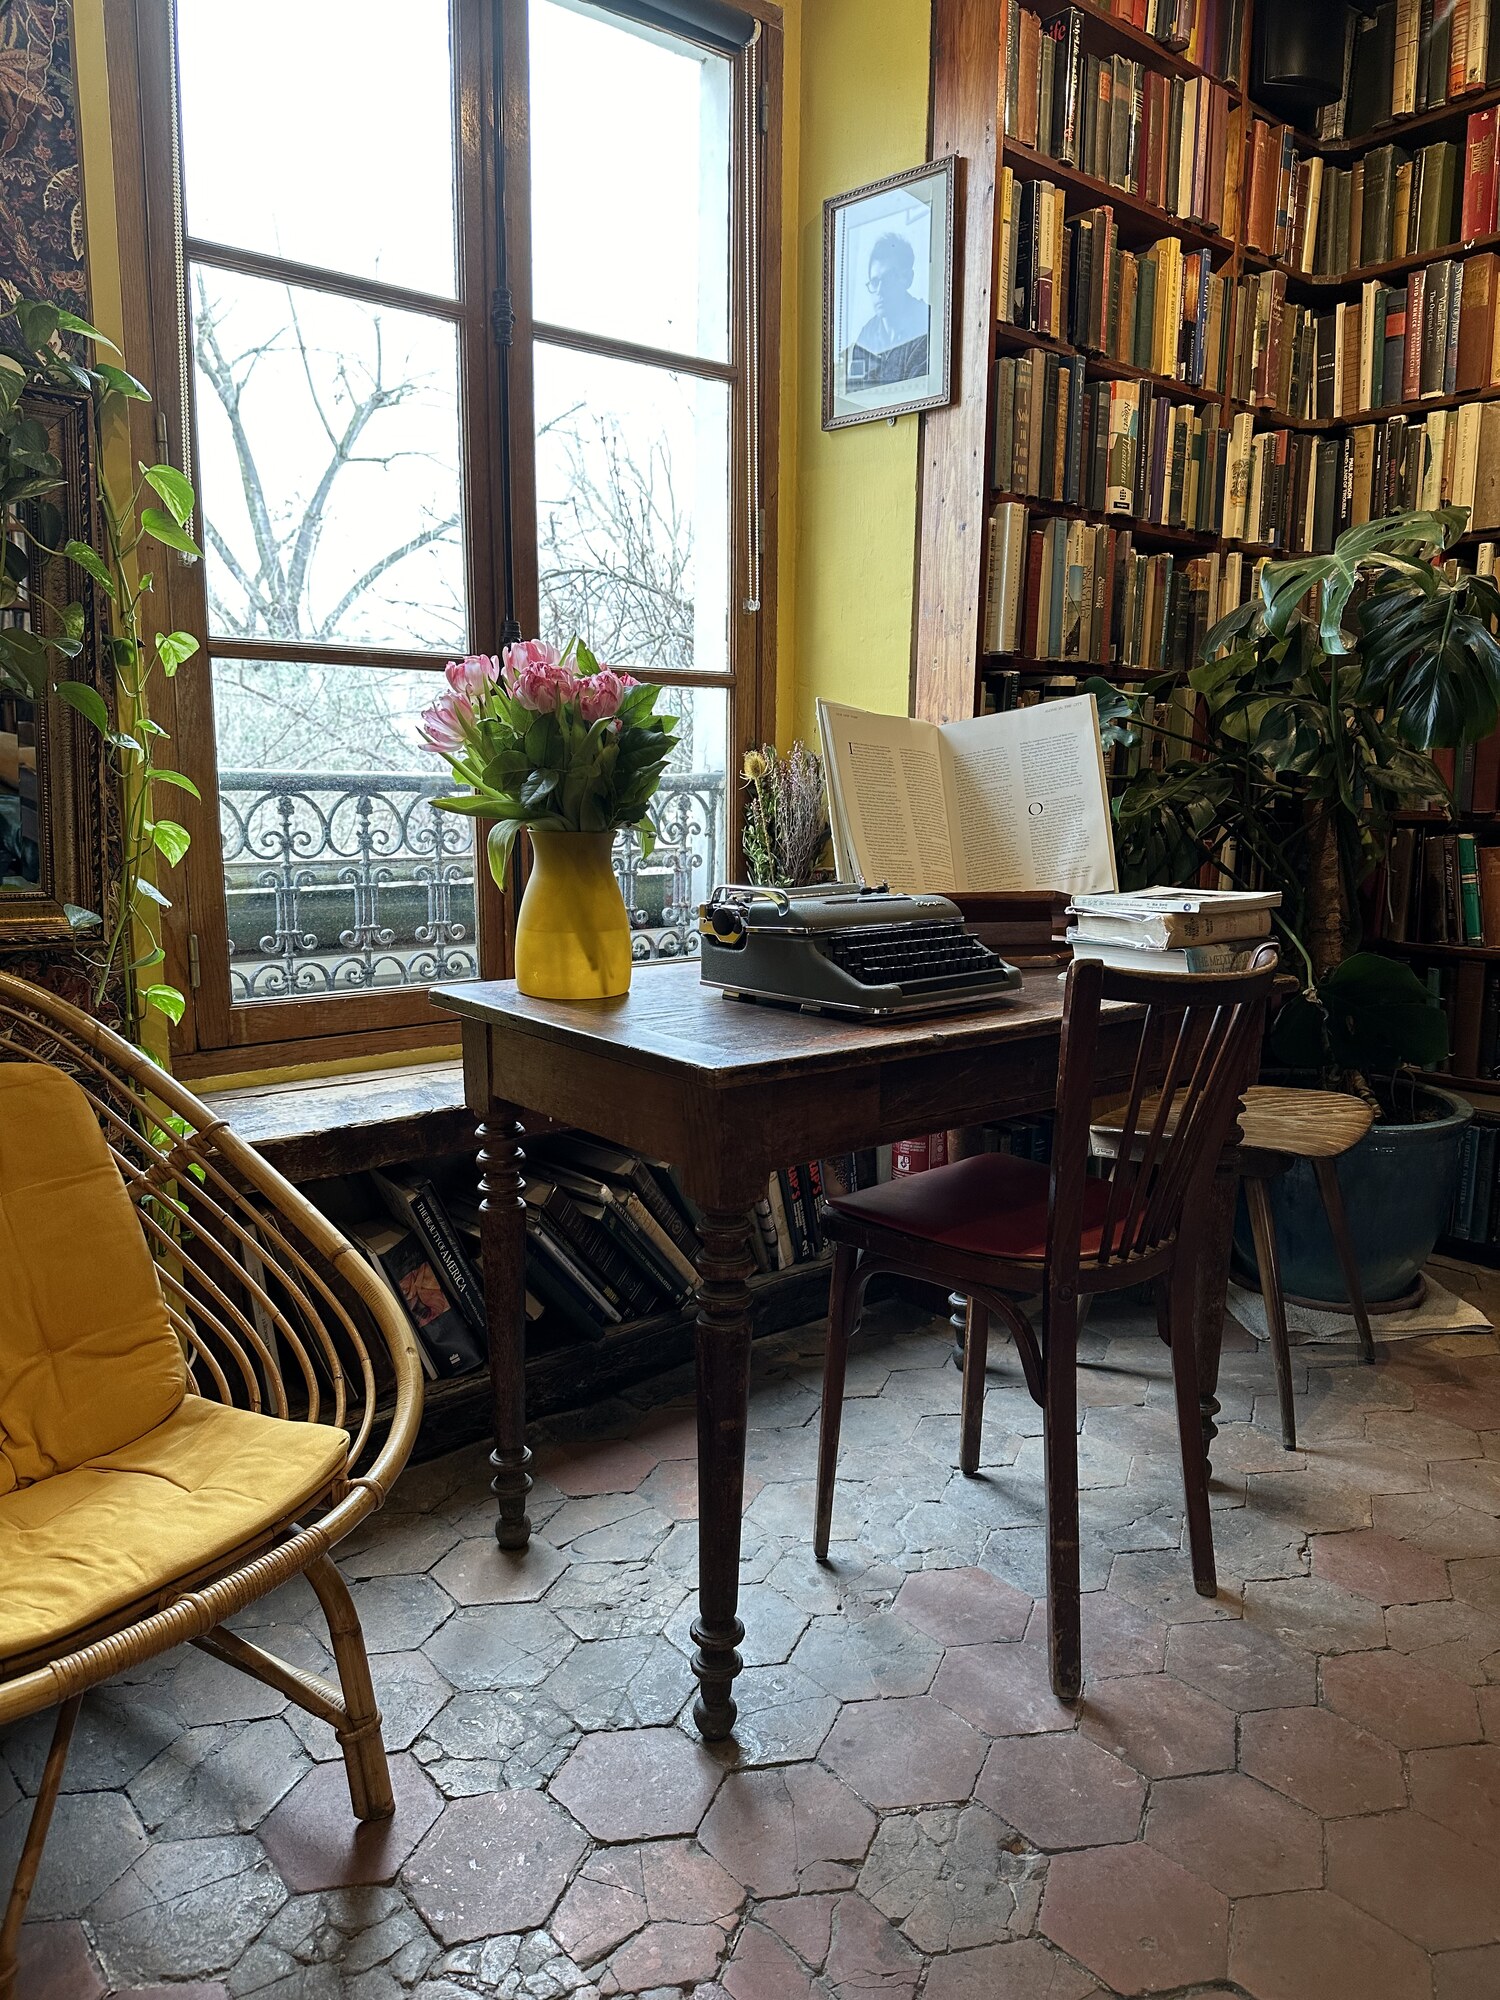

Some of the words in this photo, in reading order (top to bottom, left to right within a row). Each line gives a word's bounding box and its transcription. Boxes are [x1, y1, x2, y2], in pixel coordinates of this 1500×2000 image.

[1469, 140, 1483, 174] FINDER
[1428, 290, 1437, 303] The
[1436, 296, 1447, 325] Vladimir
[1411, 299, 1419, 328] REMNICK
[1426, 303, 1436, 331] Original
[1408, 332, 1417, 378] RESURRECTION
[1121, 401, 1132, 432] Roget's
[1120, 437, 1132, 484] Thesaurus
[1028, 802, 1044, 816] O
[1193, 954, 1209, 967] THE
[416, 1201, 428, 1218] THE
[424, 1215, 442, 1244] BEAUTY
[439, 1249, 468, 1293] AMERICA
[802, 1239, 810, 1251] 2
